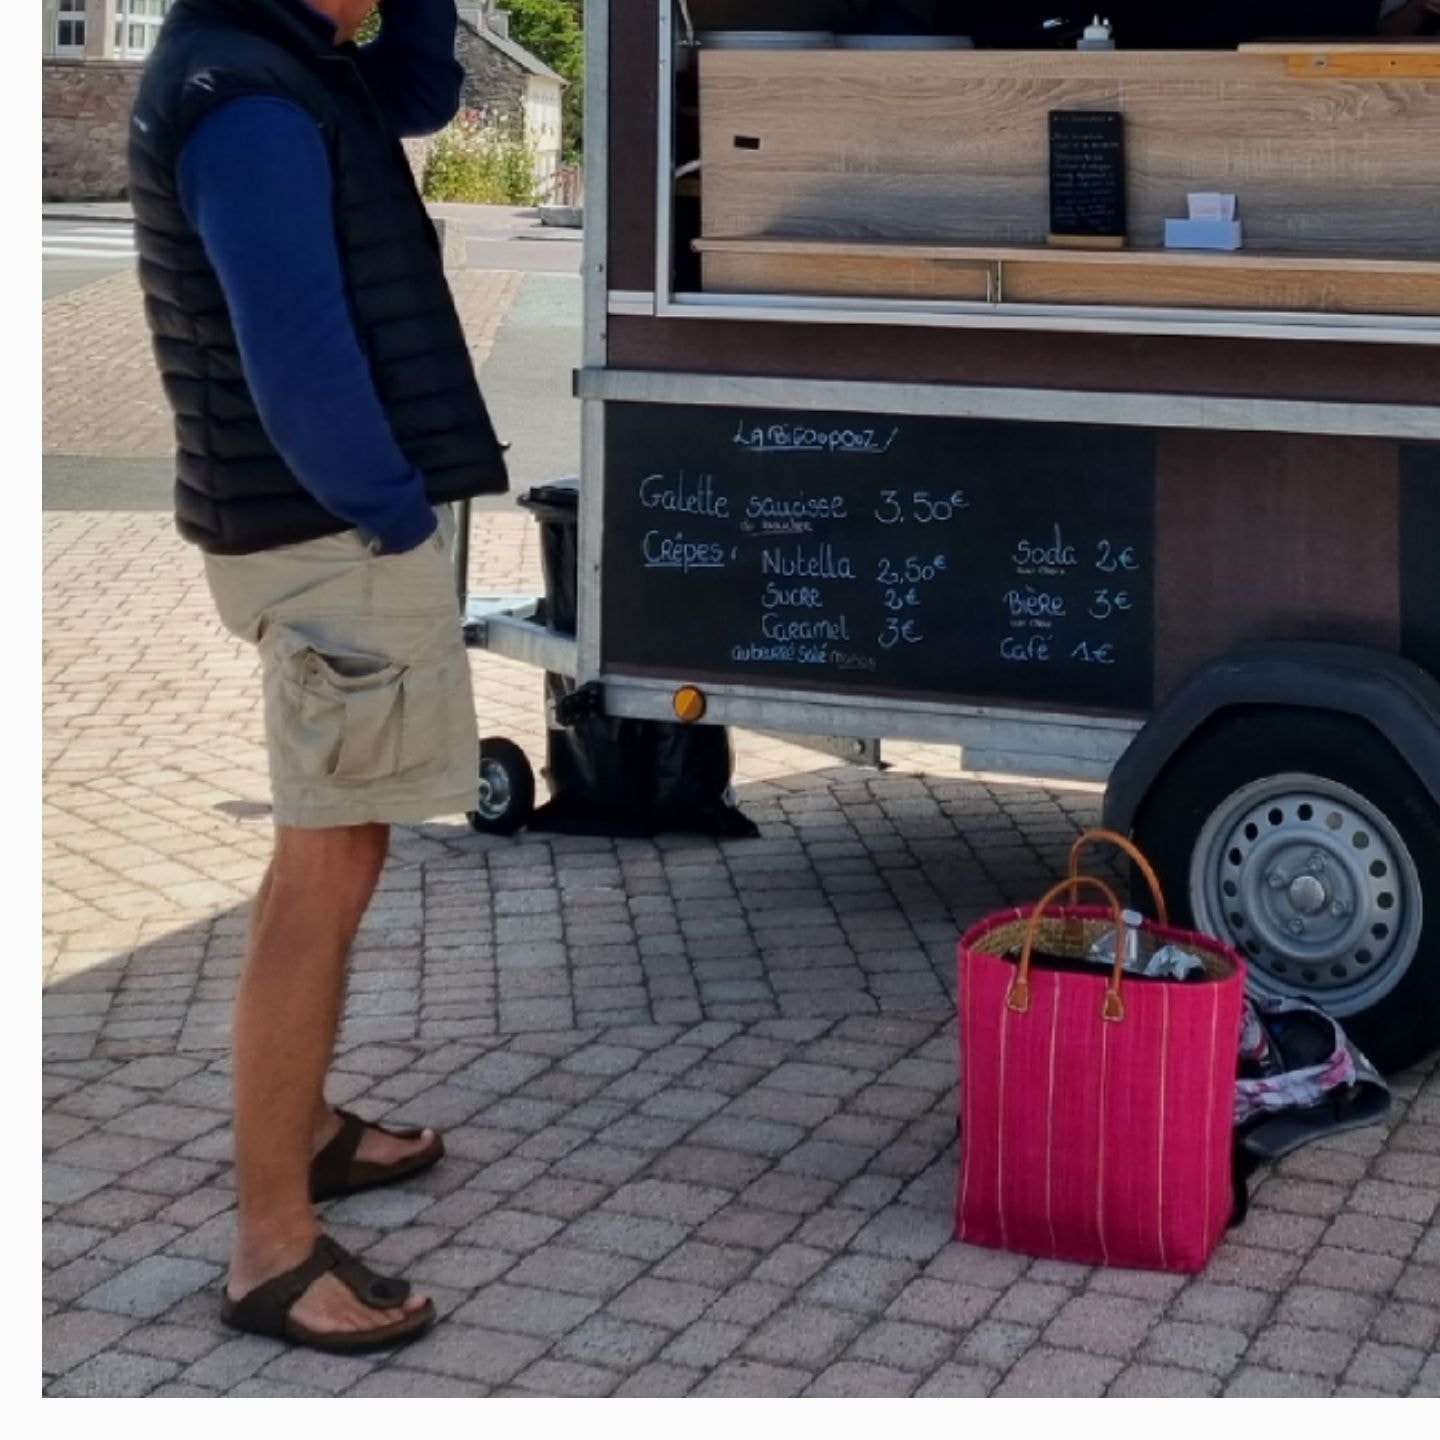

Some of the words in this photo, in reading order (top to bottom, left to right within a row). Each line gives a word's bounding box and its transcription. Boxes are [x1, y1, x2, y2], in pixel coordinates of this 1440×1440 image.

[639, 469, 730, 518] Galette
[761, 543, 857, 579] Nutella
[1012, 522, 1078, 565] Soda
[1096, 539, 1140, 572] 2€
[884, 588, 921, 610] 2€
[1089, 589, 1133, 619] 3€
[878, 617, 924, 648] 3€
[1071, 640, 1115, 664] 1€
